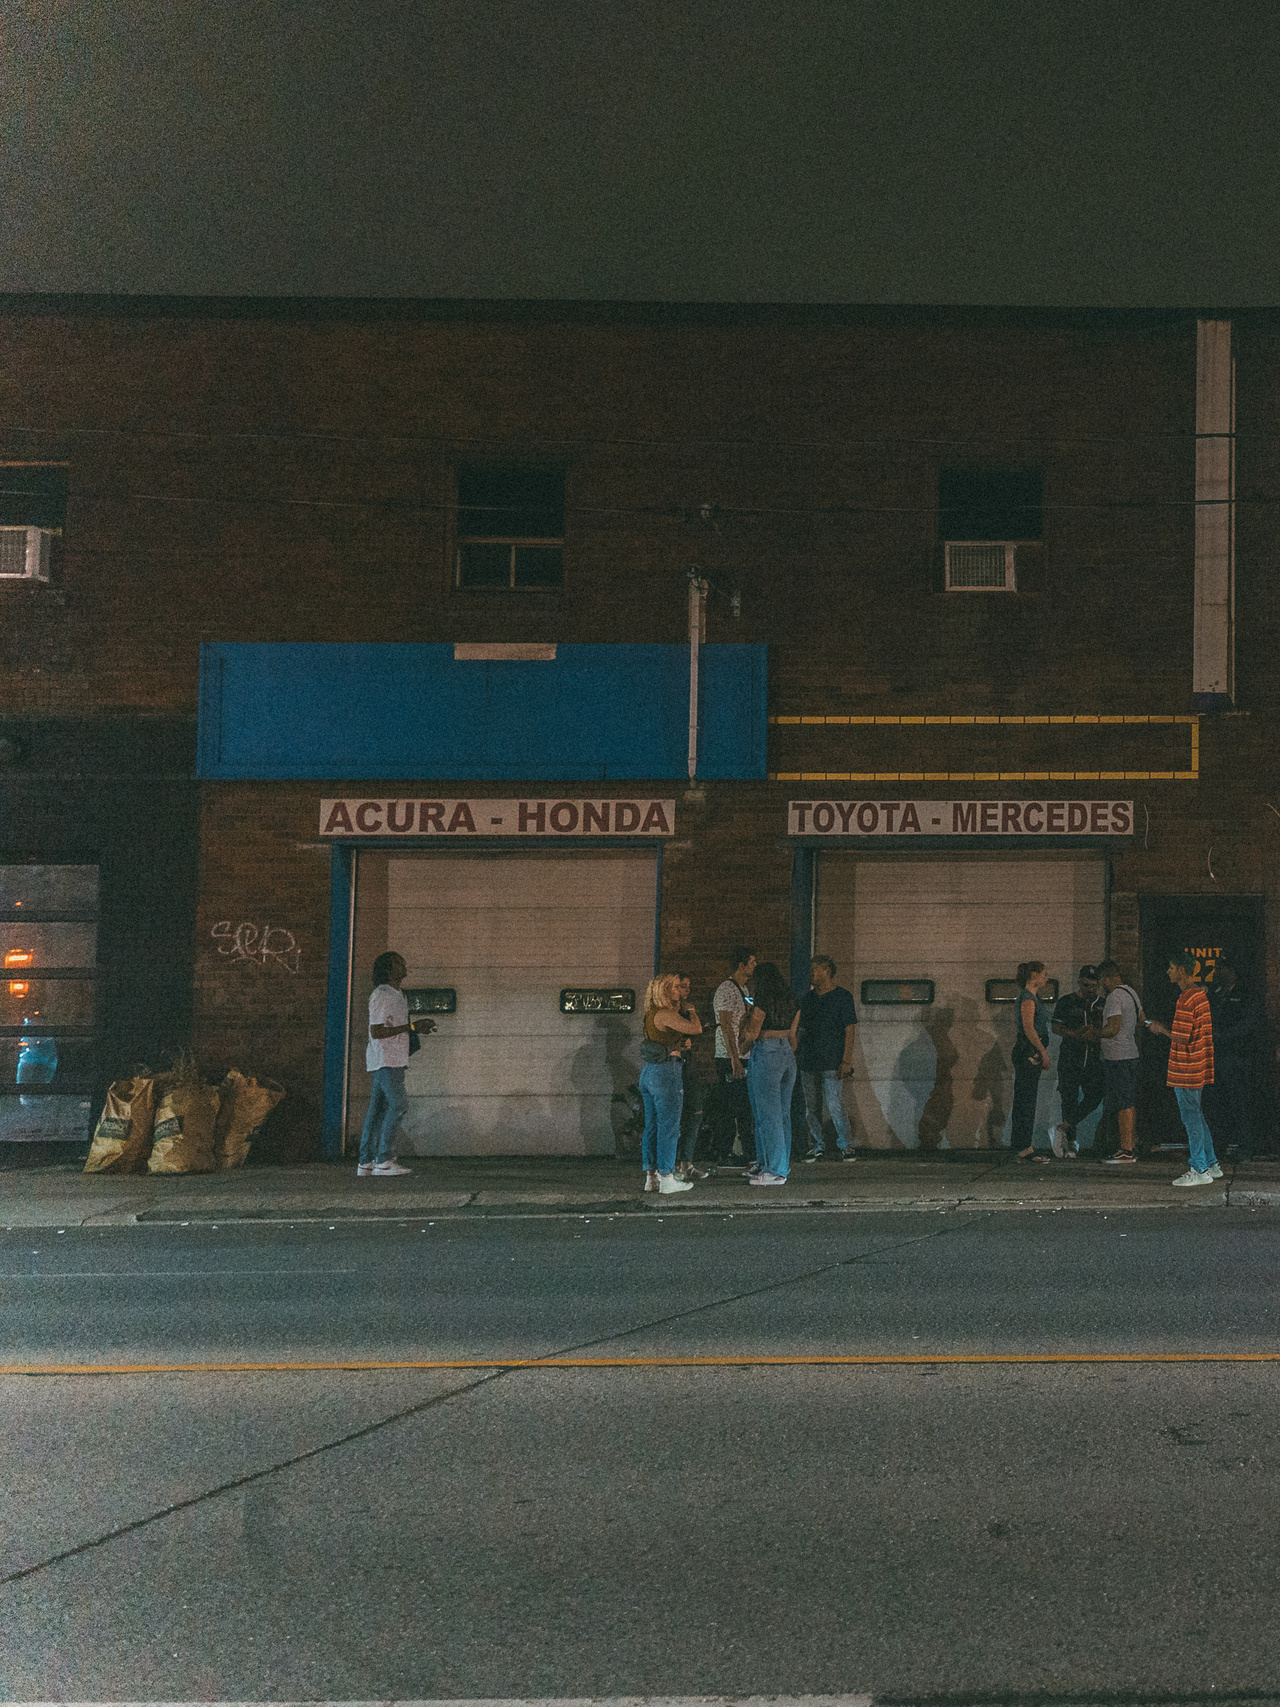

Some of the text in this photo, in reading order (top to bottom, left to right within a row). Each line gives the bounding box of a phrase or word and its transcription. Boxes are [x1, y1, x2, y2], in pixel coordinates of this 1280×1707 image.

[324, 802, 670, 833] ACURA - HONDA
[792, 802, 1130, 833] TOYOTA - MERCEDES
